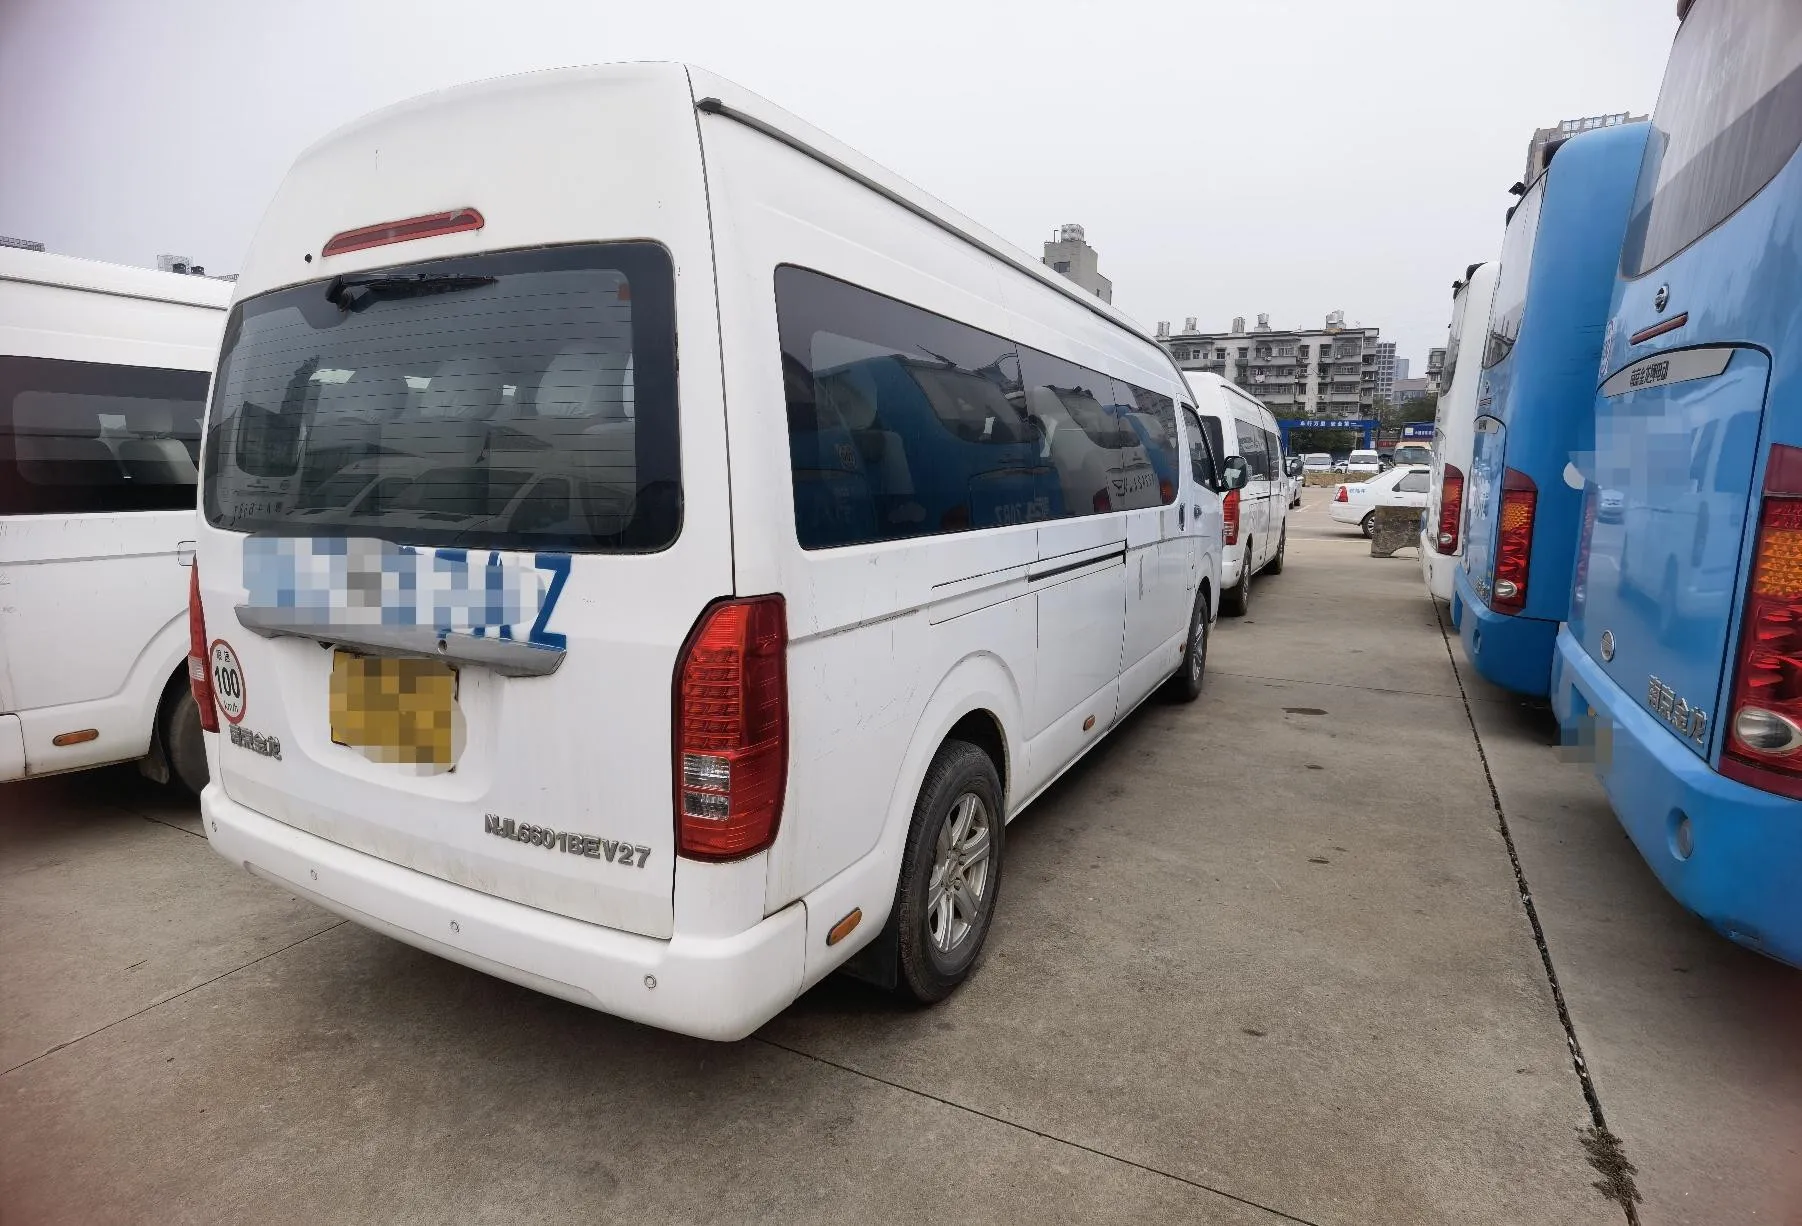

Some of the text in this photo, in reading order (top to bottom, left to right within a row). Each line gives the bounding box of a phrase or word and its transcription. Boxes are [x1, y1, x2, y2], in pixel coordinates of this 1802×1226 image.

[214, 665, 241, 699] 100
[1648, 673, 1708, 745] 南京金龙
[229, 724, 283, 761] 南京金龙
[484, 812, 652, 869] NJL6601BEV27
